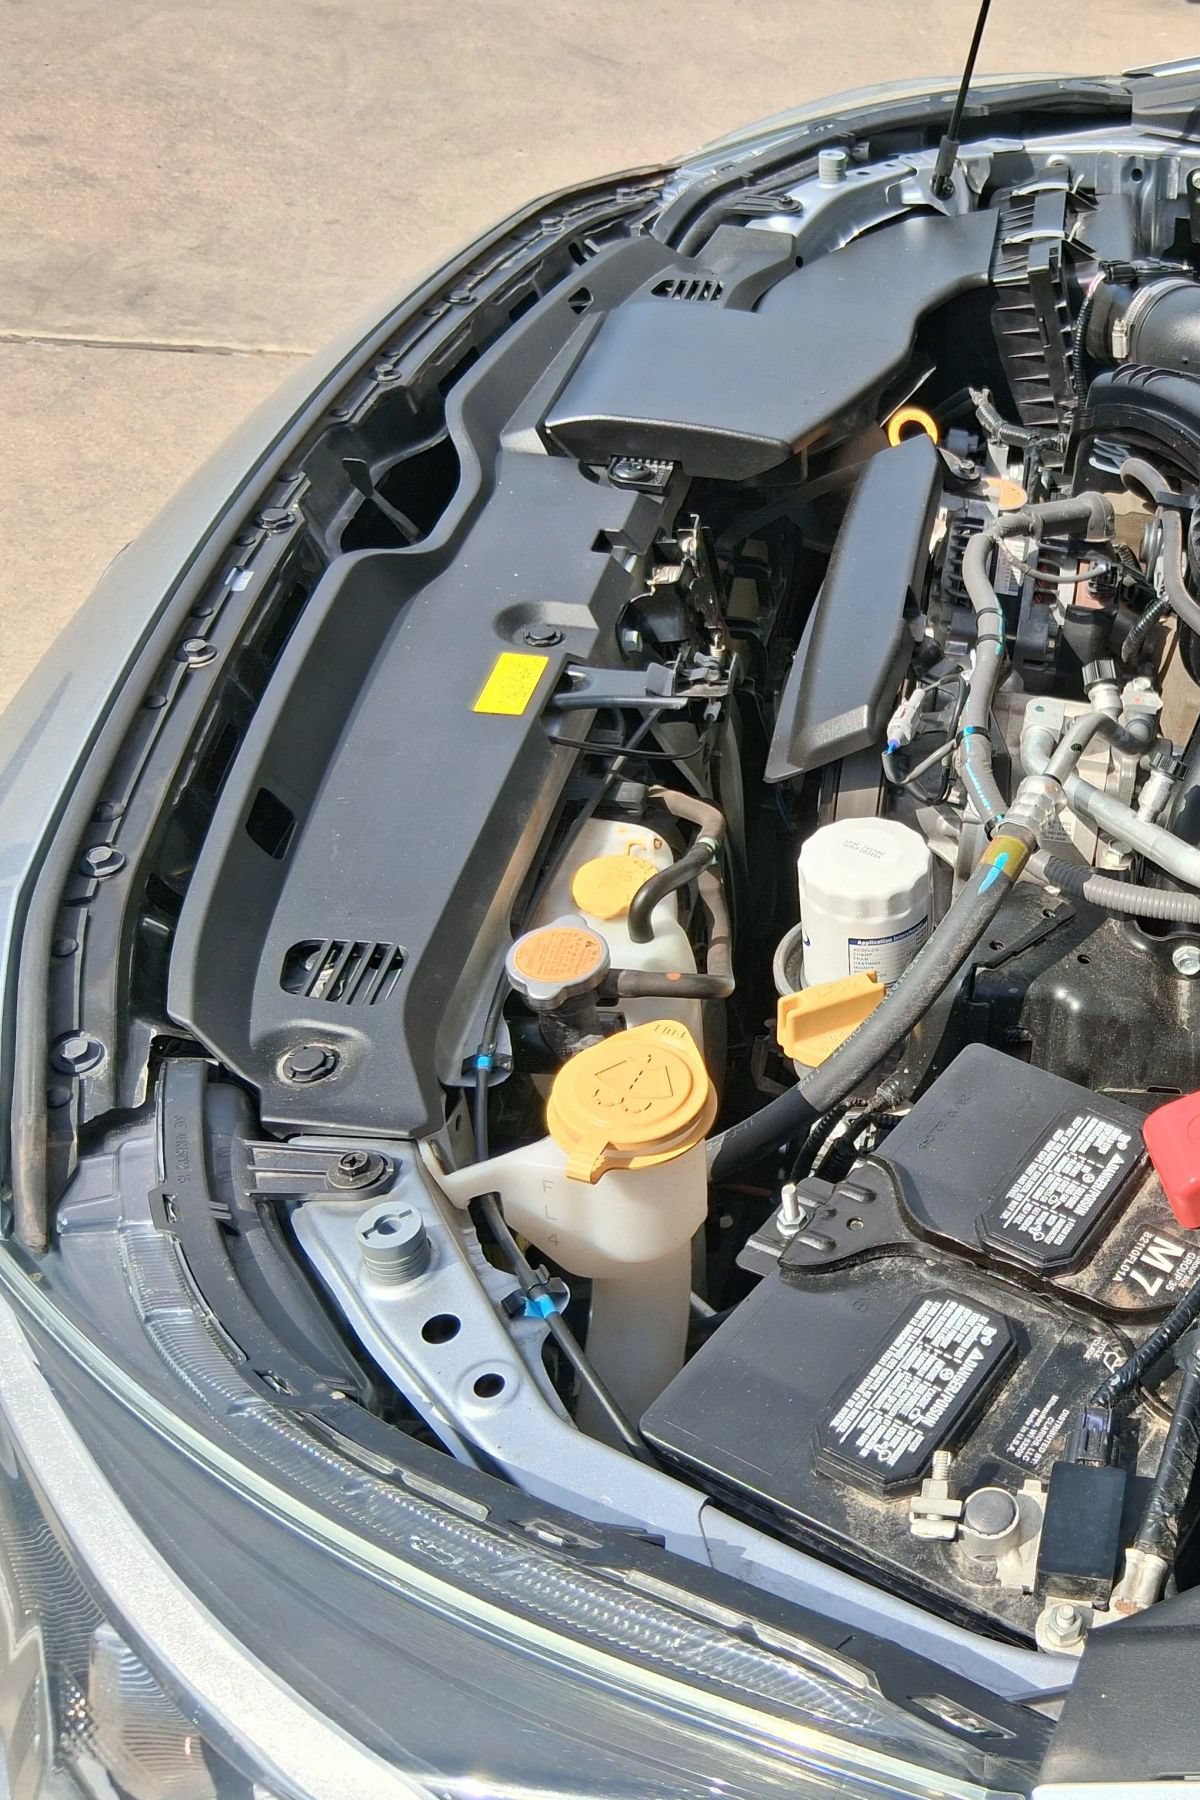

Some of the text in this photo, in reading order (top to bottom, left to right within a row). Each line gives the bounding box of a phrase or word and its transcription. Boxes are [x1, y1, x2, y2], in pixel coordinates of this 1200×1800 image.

[1072, 1161, 1120, 1217] DANGER/POISON
[1112, 1231, 1154, 1281] 82110FL01A
[1129, 1236, 1185, 1296] M 7
[1174, 1252, 1196, 1280] GROUP
[1165, 1280, 1177, 1292] 35
[1178, 1276, 1190, 1288] SIZE
[920, 1357, 979, 1427] DANGER/POISON
[1032, 1395, 1059, 1428] Milwaukee,
[1006, 1408, 1040, 1453] Made in U.S.A.
[1014, 1438, 1030, 1457] 53209
[1023, 1417, 1054, 1461] CLARIOS, LLC
[1030, 1409, 1070, 1465] DISTRIBUTED BY:
